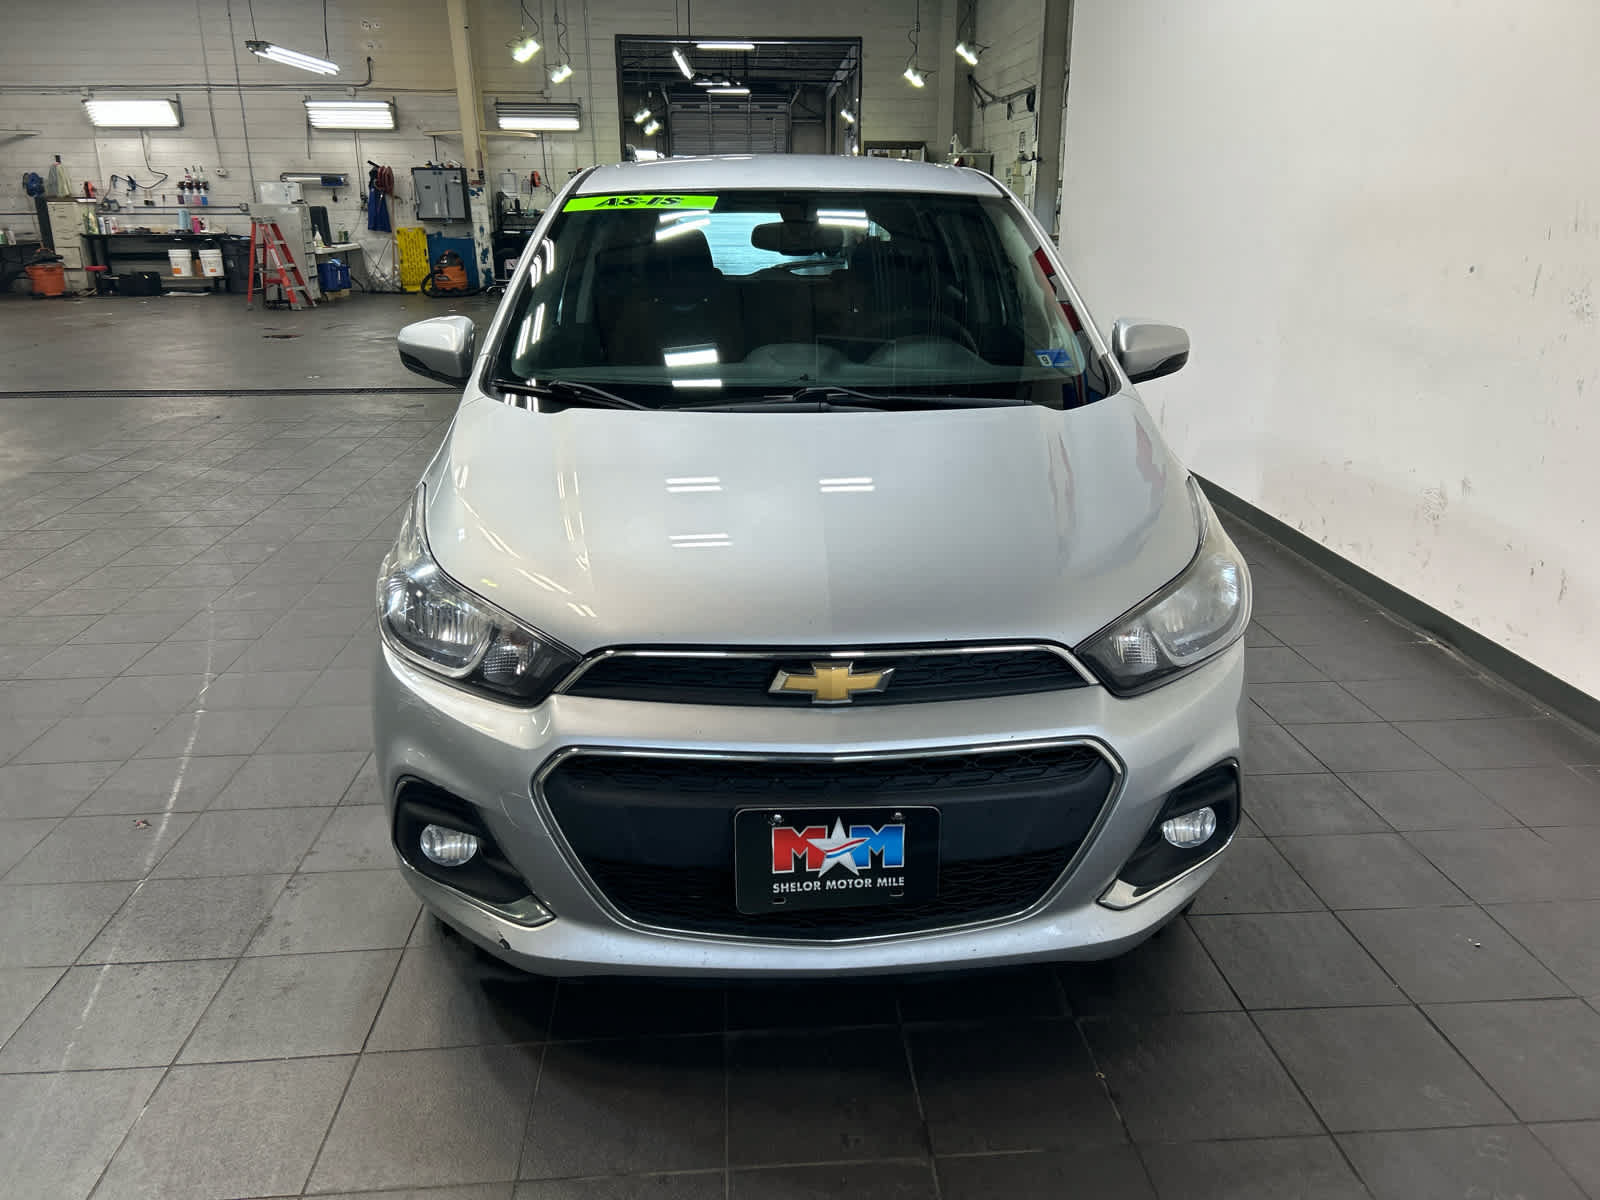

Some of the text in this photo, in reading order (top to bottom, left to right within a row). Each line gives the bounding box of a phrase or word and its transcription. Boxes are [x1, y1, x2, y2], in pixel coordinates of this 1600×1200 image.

[594, 197, 684, 207] AS-IS
[772, 876, 905, 893] SHELOR MOTOR MILE
